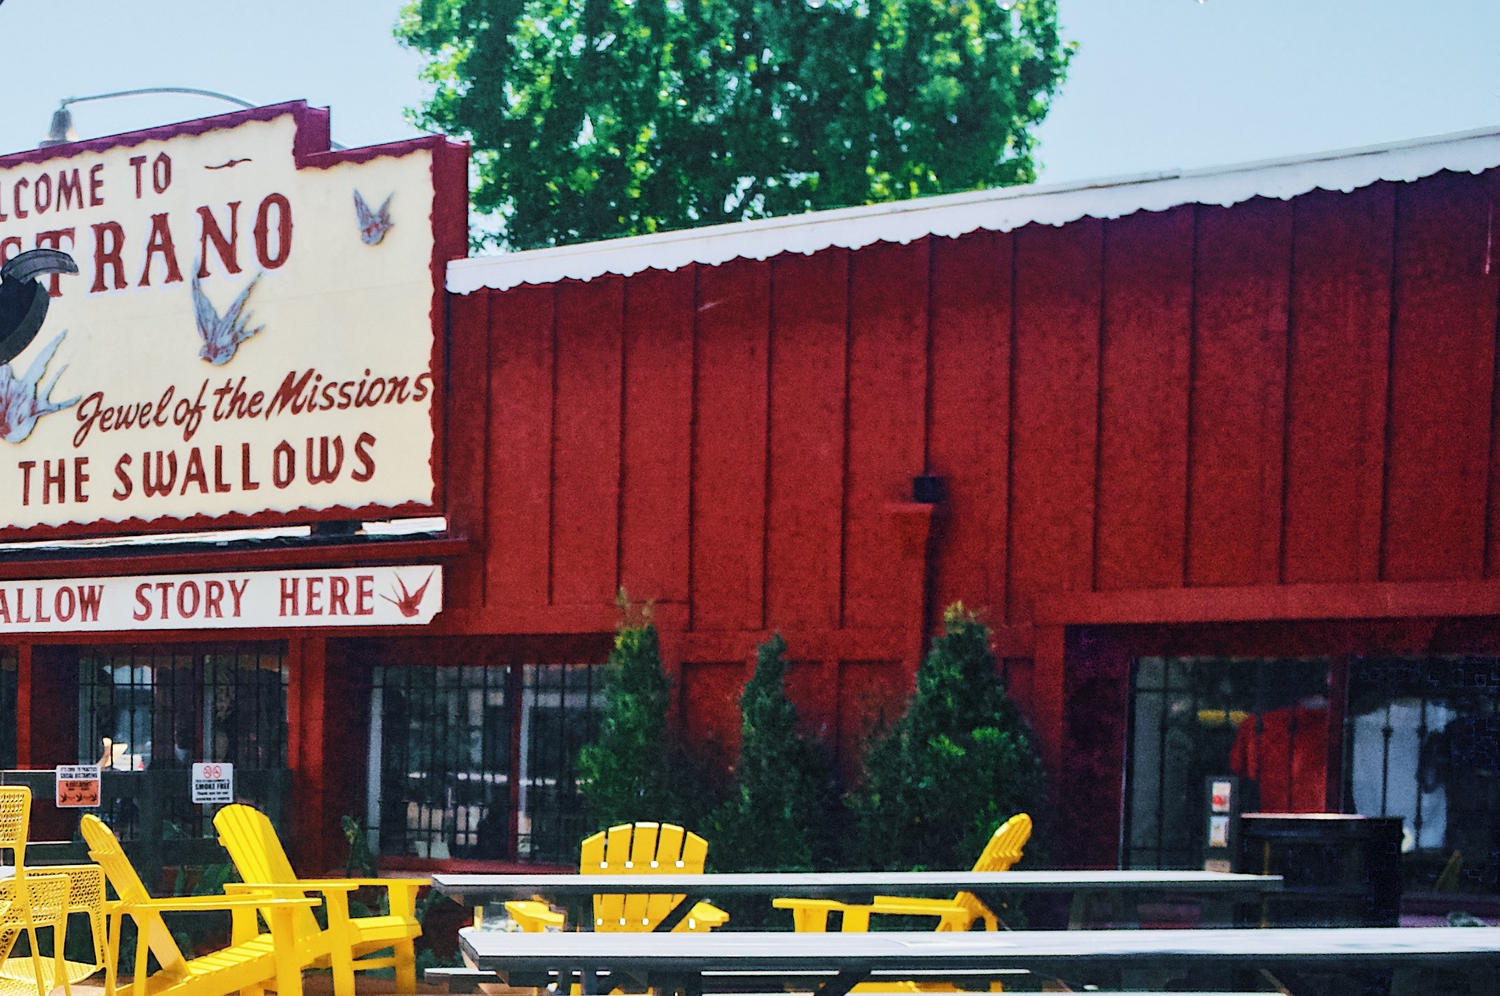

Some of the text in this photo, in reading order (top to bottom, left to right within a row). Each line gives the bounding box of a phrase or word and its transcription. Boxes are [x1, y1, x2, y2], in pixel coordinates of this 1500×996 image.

[129, 151, 171, 199] TO
[72, 368, 434, 448] Jewel of the Missions
[18, 456, 90, 506] THE
[112, 431, 377, 501] SWALLOWS
[133, 578, 250, 620] STORY
[278, 575, 375, 617] HERE
